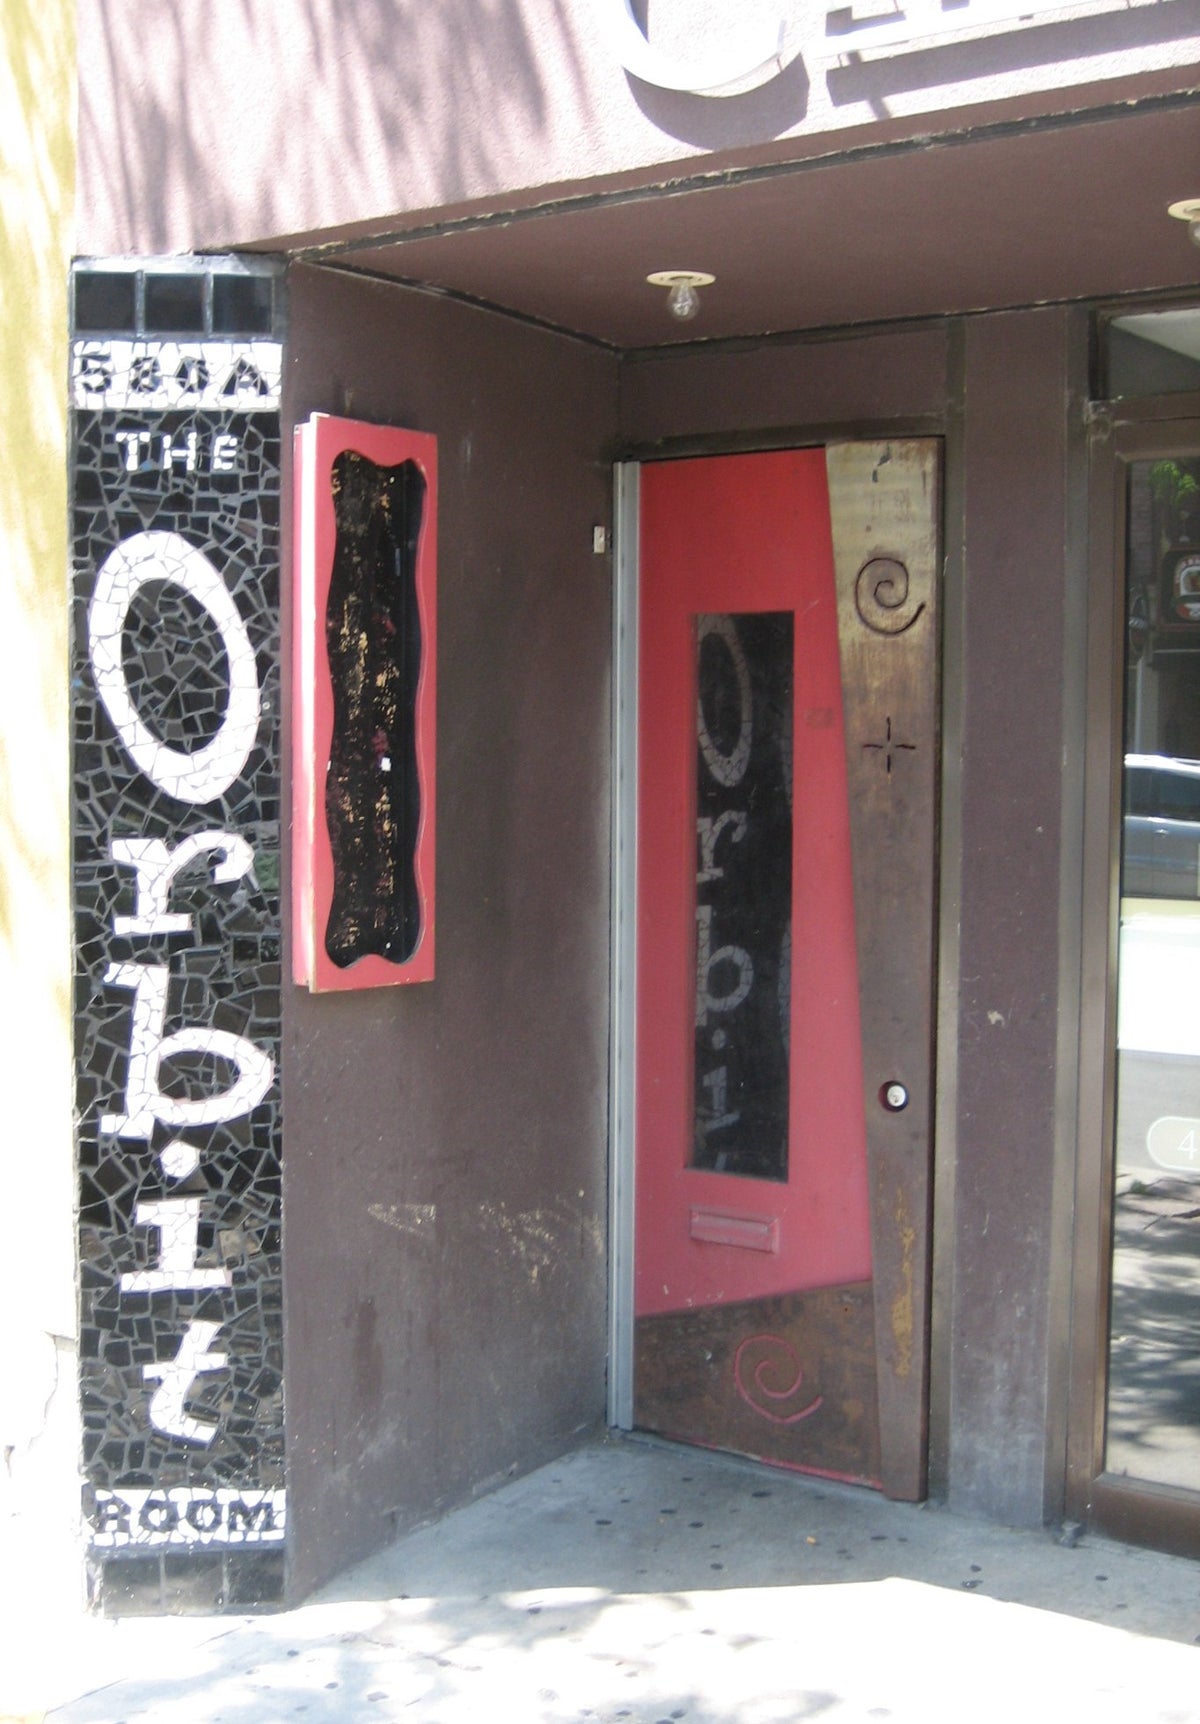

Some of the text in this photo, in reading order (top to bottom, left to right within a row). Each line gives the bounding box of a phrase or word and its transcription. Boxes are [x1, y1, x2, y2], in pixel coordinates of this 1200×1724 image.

[80, 351, 269, 395] 580A
[115, 431, 238, 471] THE
[695, 613, 754, 1169] Orbi
[89, 530, 274, 1443] Orbit
[94, 1498, 274, 1533] ROOM
